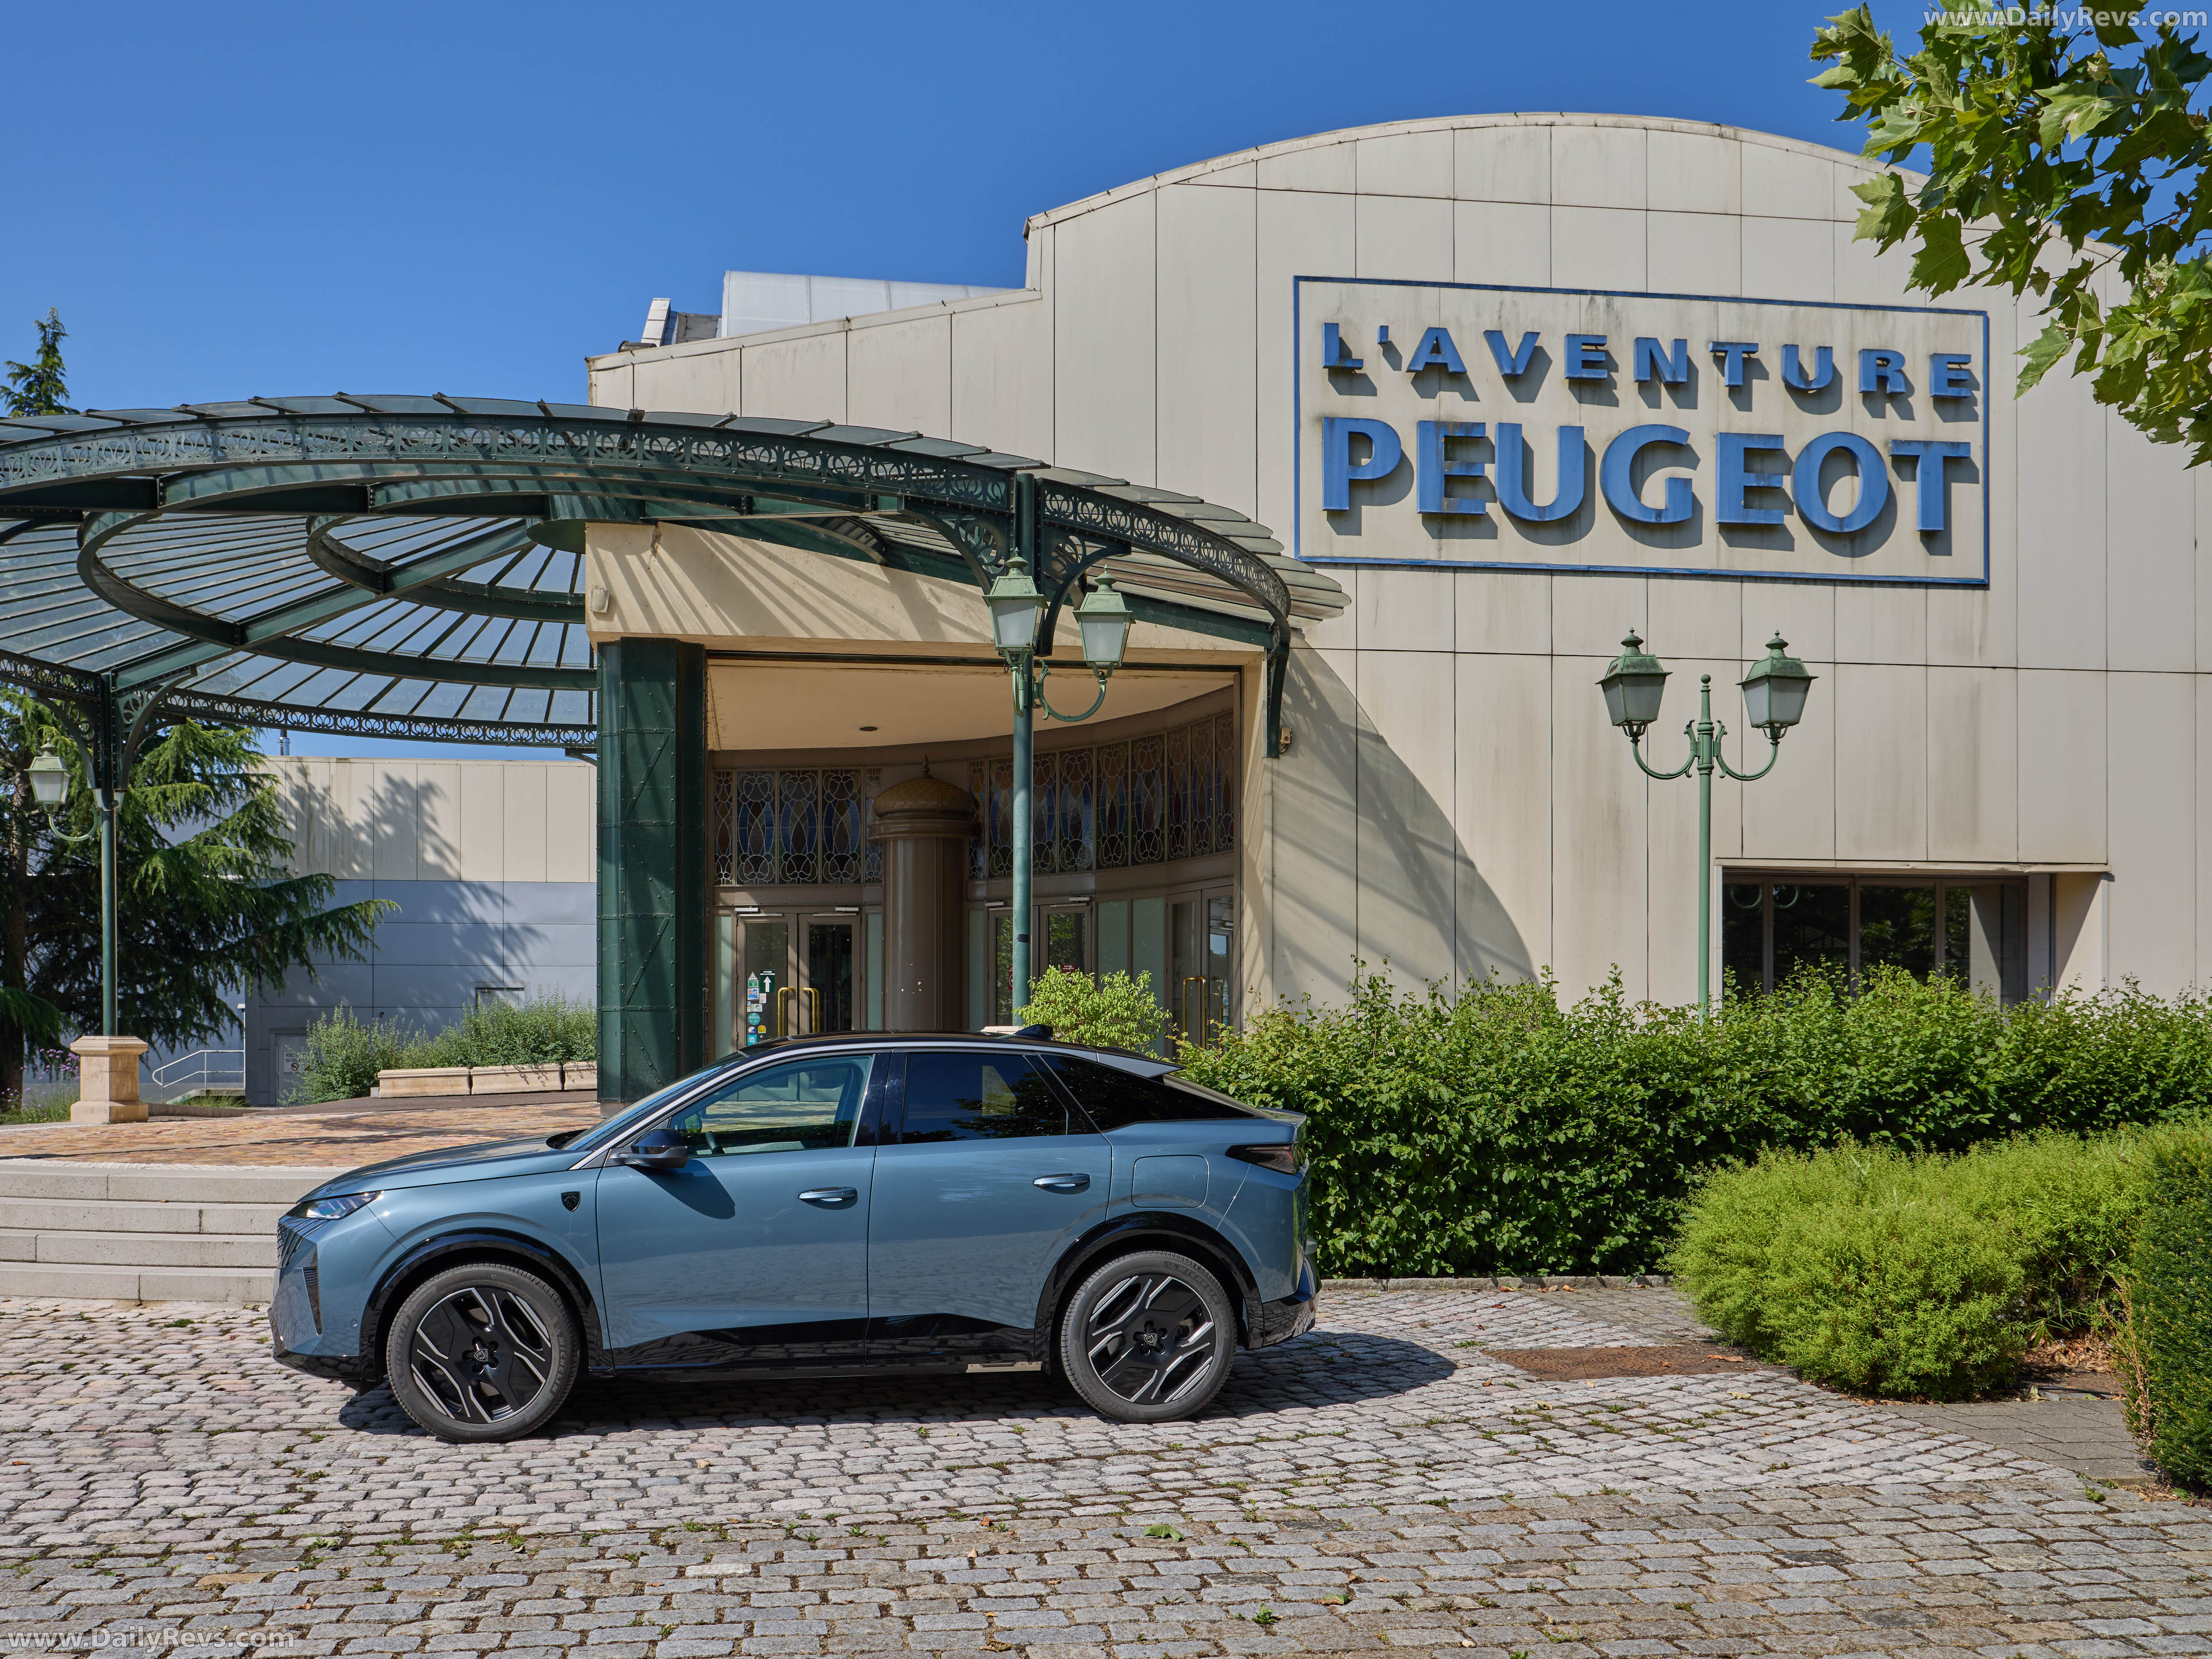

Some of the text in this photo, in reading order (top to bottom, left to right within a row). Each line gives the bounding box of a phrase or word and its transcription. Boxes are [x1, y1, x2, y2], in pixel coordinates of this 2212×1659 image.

[1321, 322, 1972, 399] L'AVENTURE
[1321, 416, 1971, 533] PEUGEOT
[551, 1336, 567, 1393] MICHELIN
